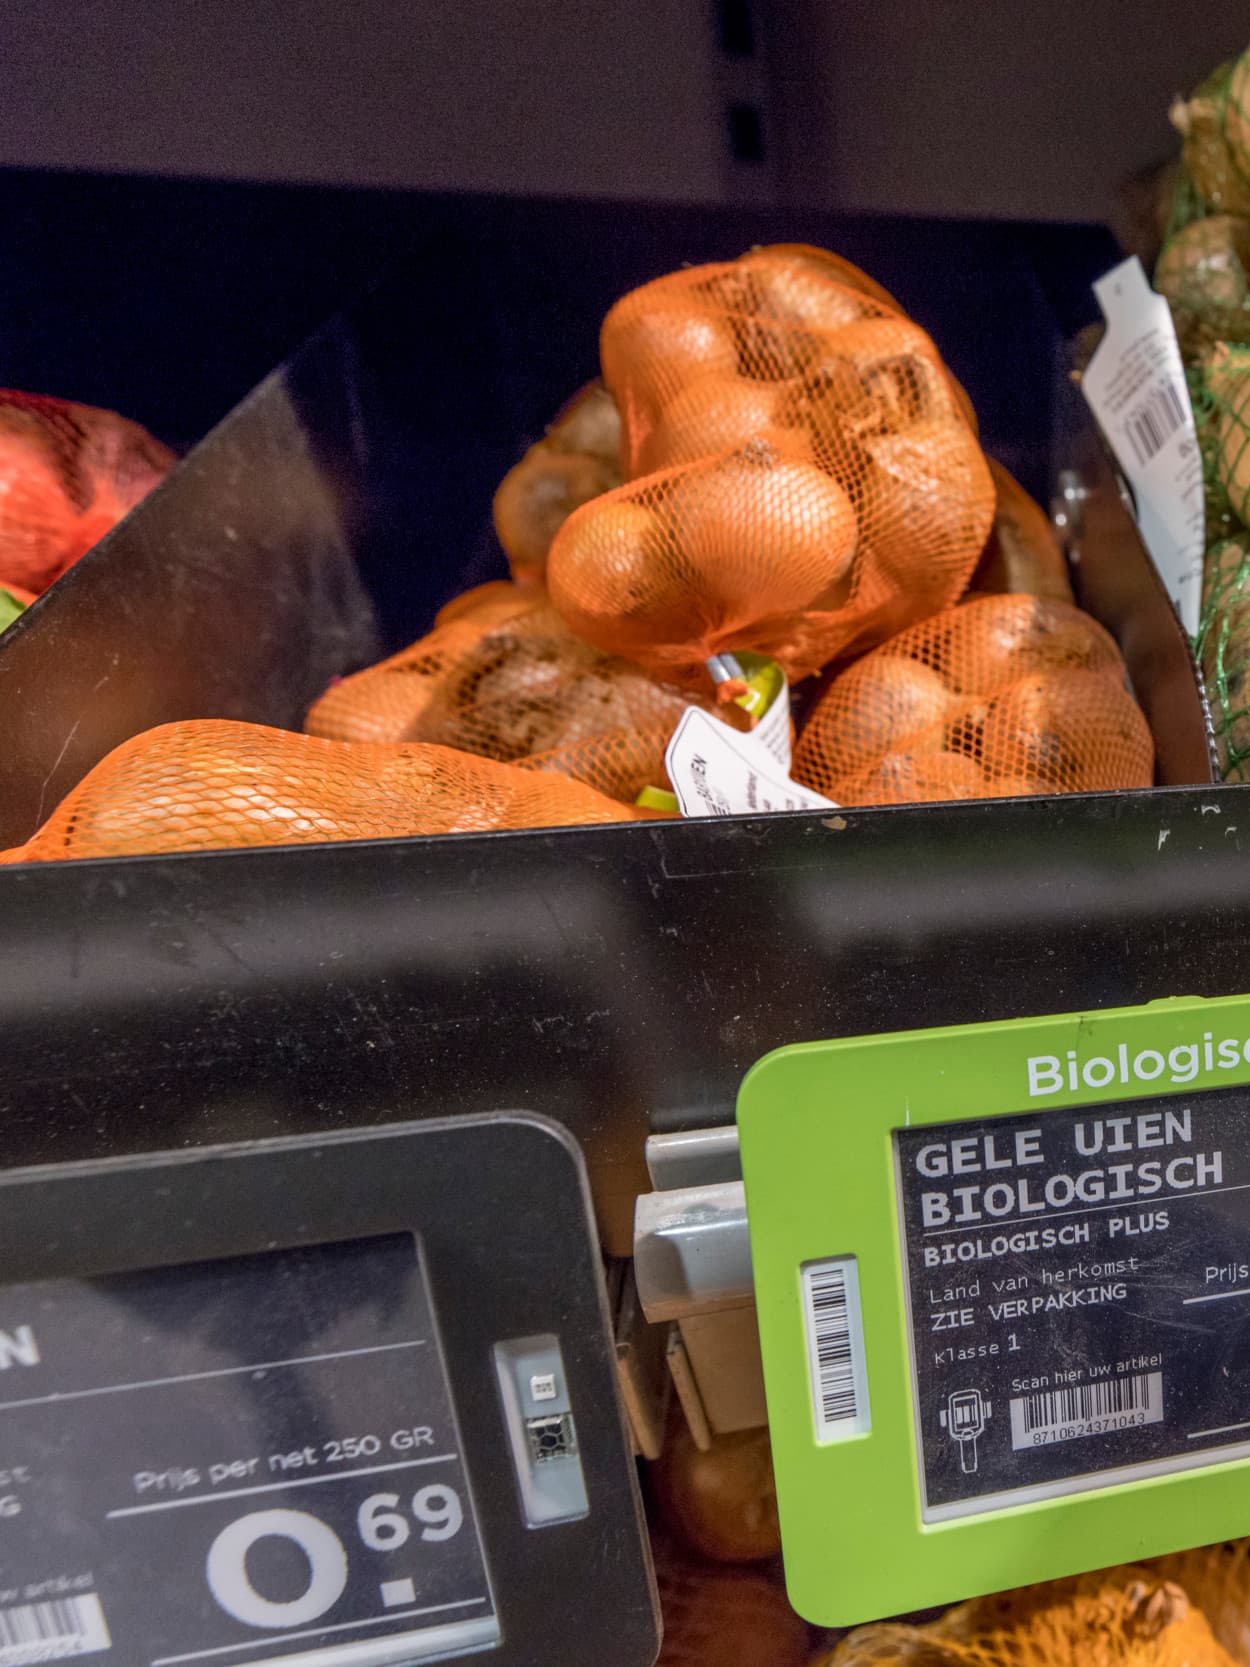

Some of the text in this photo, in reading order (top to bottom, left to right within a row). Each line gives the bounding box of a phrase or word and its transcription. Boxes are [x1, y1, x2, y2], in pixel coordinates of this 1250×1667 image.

[916, 1109, 1193, 1178] GELE UIEN
[921, 1151, 1223, 1228] BIOLOGISCH
[924, 1212, 1170, 1267] BIOLOGISCH PLUS
[930, 1256, 1140, 1304] Land van herkomst
[1205, 1262, 1249, 1284] Prijs
[931, 1283, 1128, 1331] ZIE VERPAKKING
[934, 1333, 1021, 1365] Klasse 1
[1012, 1353, 1162, 1392] Scan hier uw artikel
[1032, 1412, 1145, 1445] 8710624371043
[133, 1425, 434, 1494] Prijs per net 250 GR
